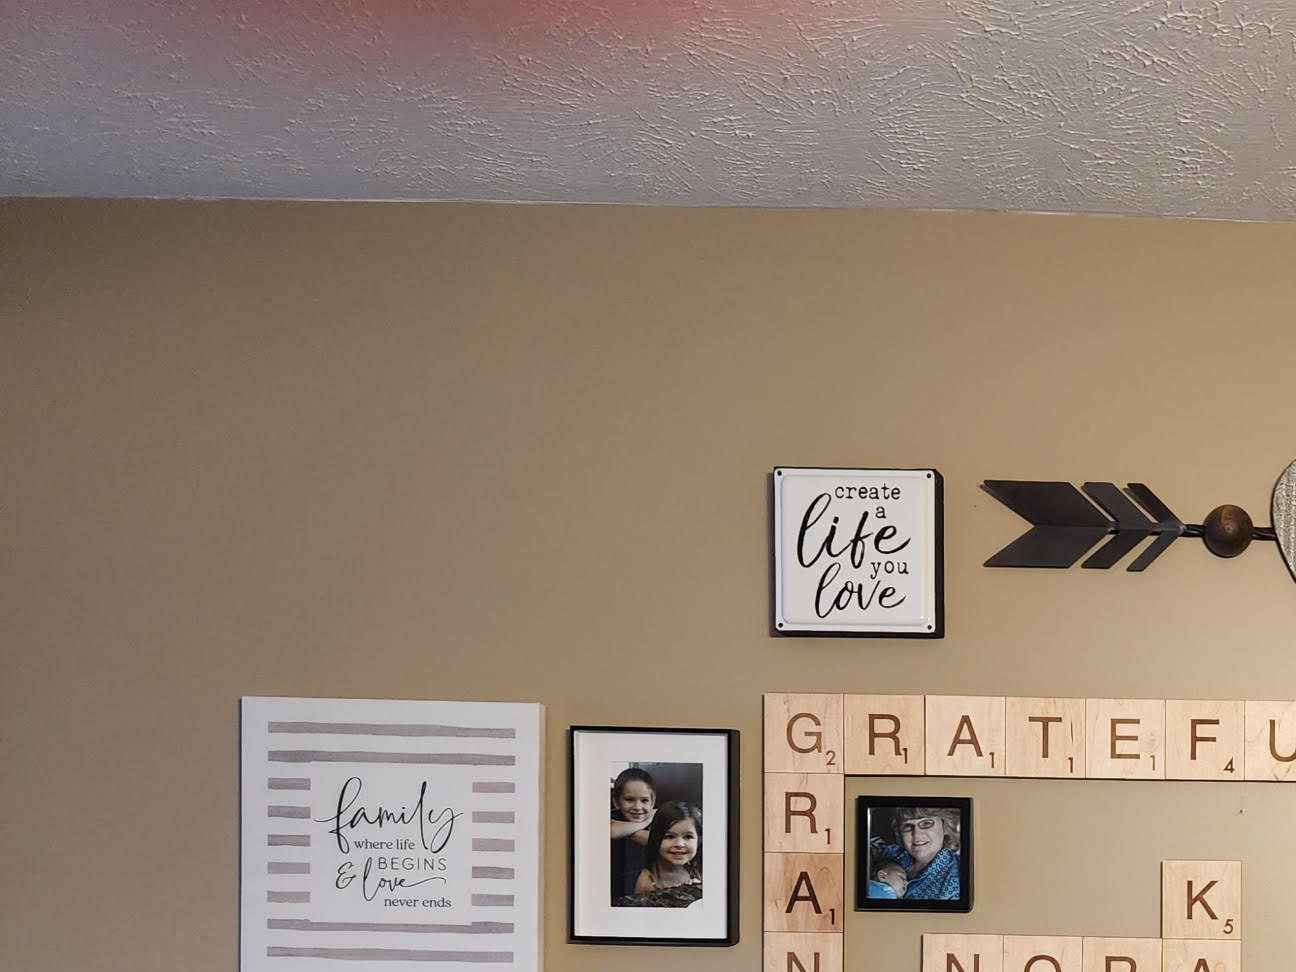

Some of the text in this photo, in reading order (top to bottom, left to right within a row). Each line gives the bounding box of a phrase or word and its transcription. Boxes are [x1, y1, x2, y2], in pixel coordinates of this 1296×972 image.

[834, 483, 901, 500] create
[875, 506, 887, 519] a
[797, 492, 911, 569] life
[870, 561, 909, 580] you
[815, 562, 906, 618] love
[313, 777, 464, 854] family
[354, 838, 415, 850] where life
[378, 857, 447, 871] BEGINS
[363, 857, 446, 902] love
[384, 897, 452, 908] never ends
